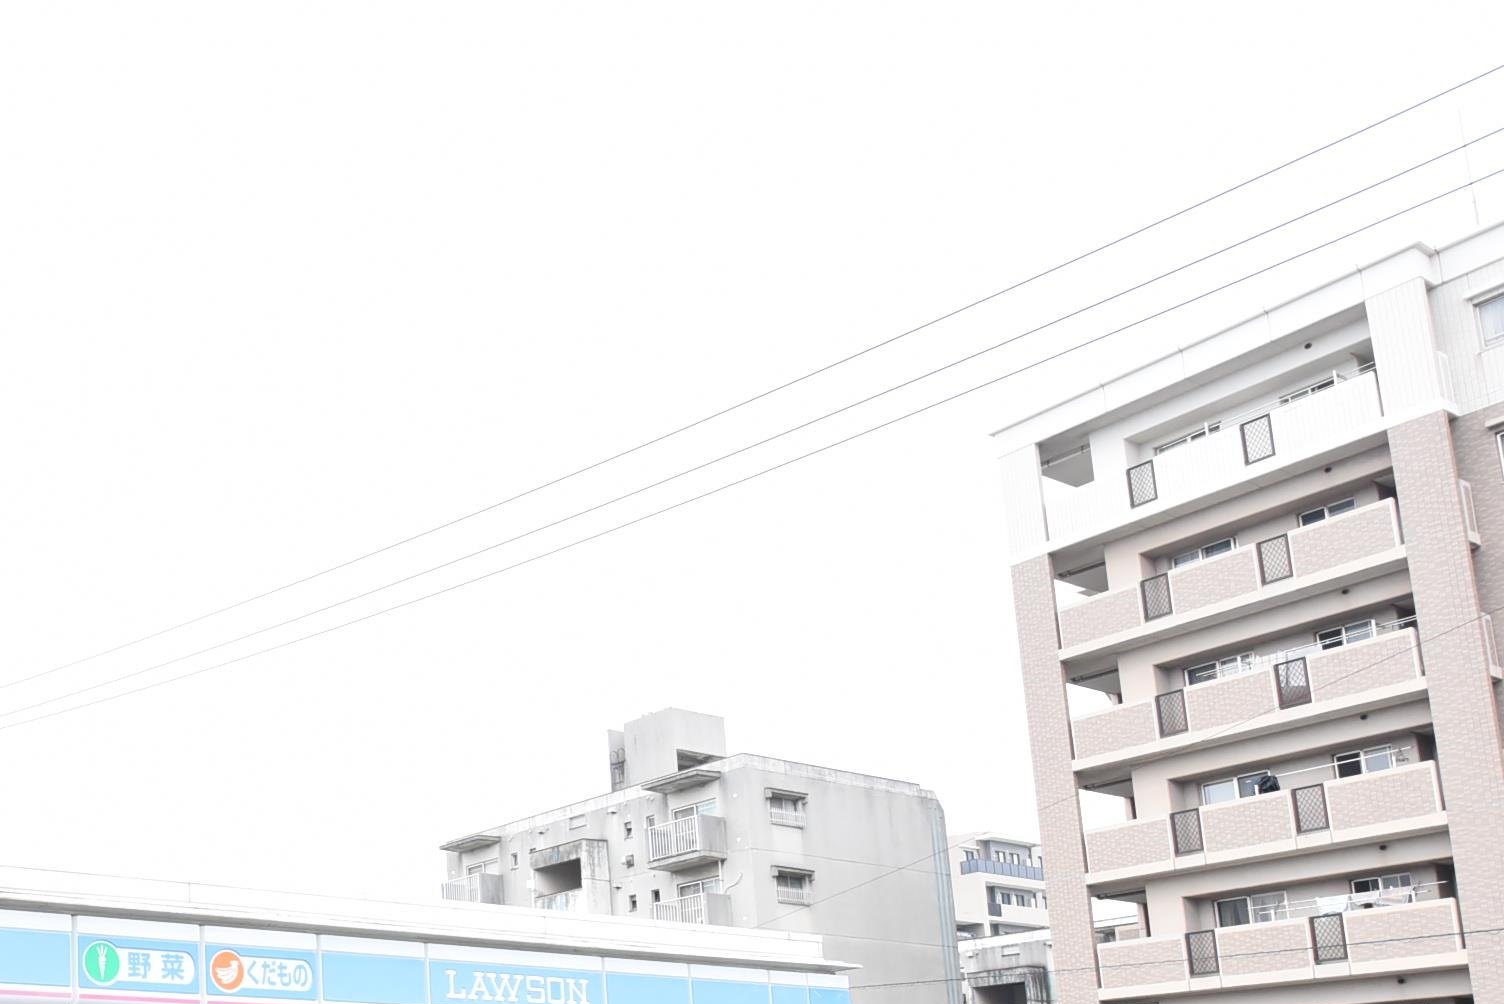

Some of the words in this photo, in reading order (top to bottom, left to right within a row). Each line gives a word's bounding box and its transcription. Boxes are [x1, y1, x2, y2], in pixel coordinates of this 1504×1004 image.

[127, 951, 185, 980] 野菜
[247, 960, 308, 987] くだもの
